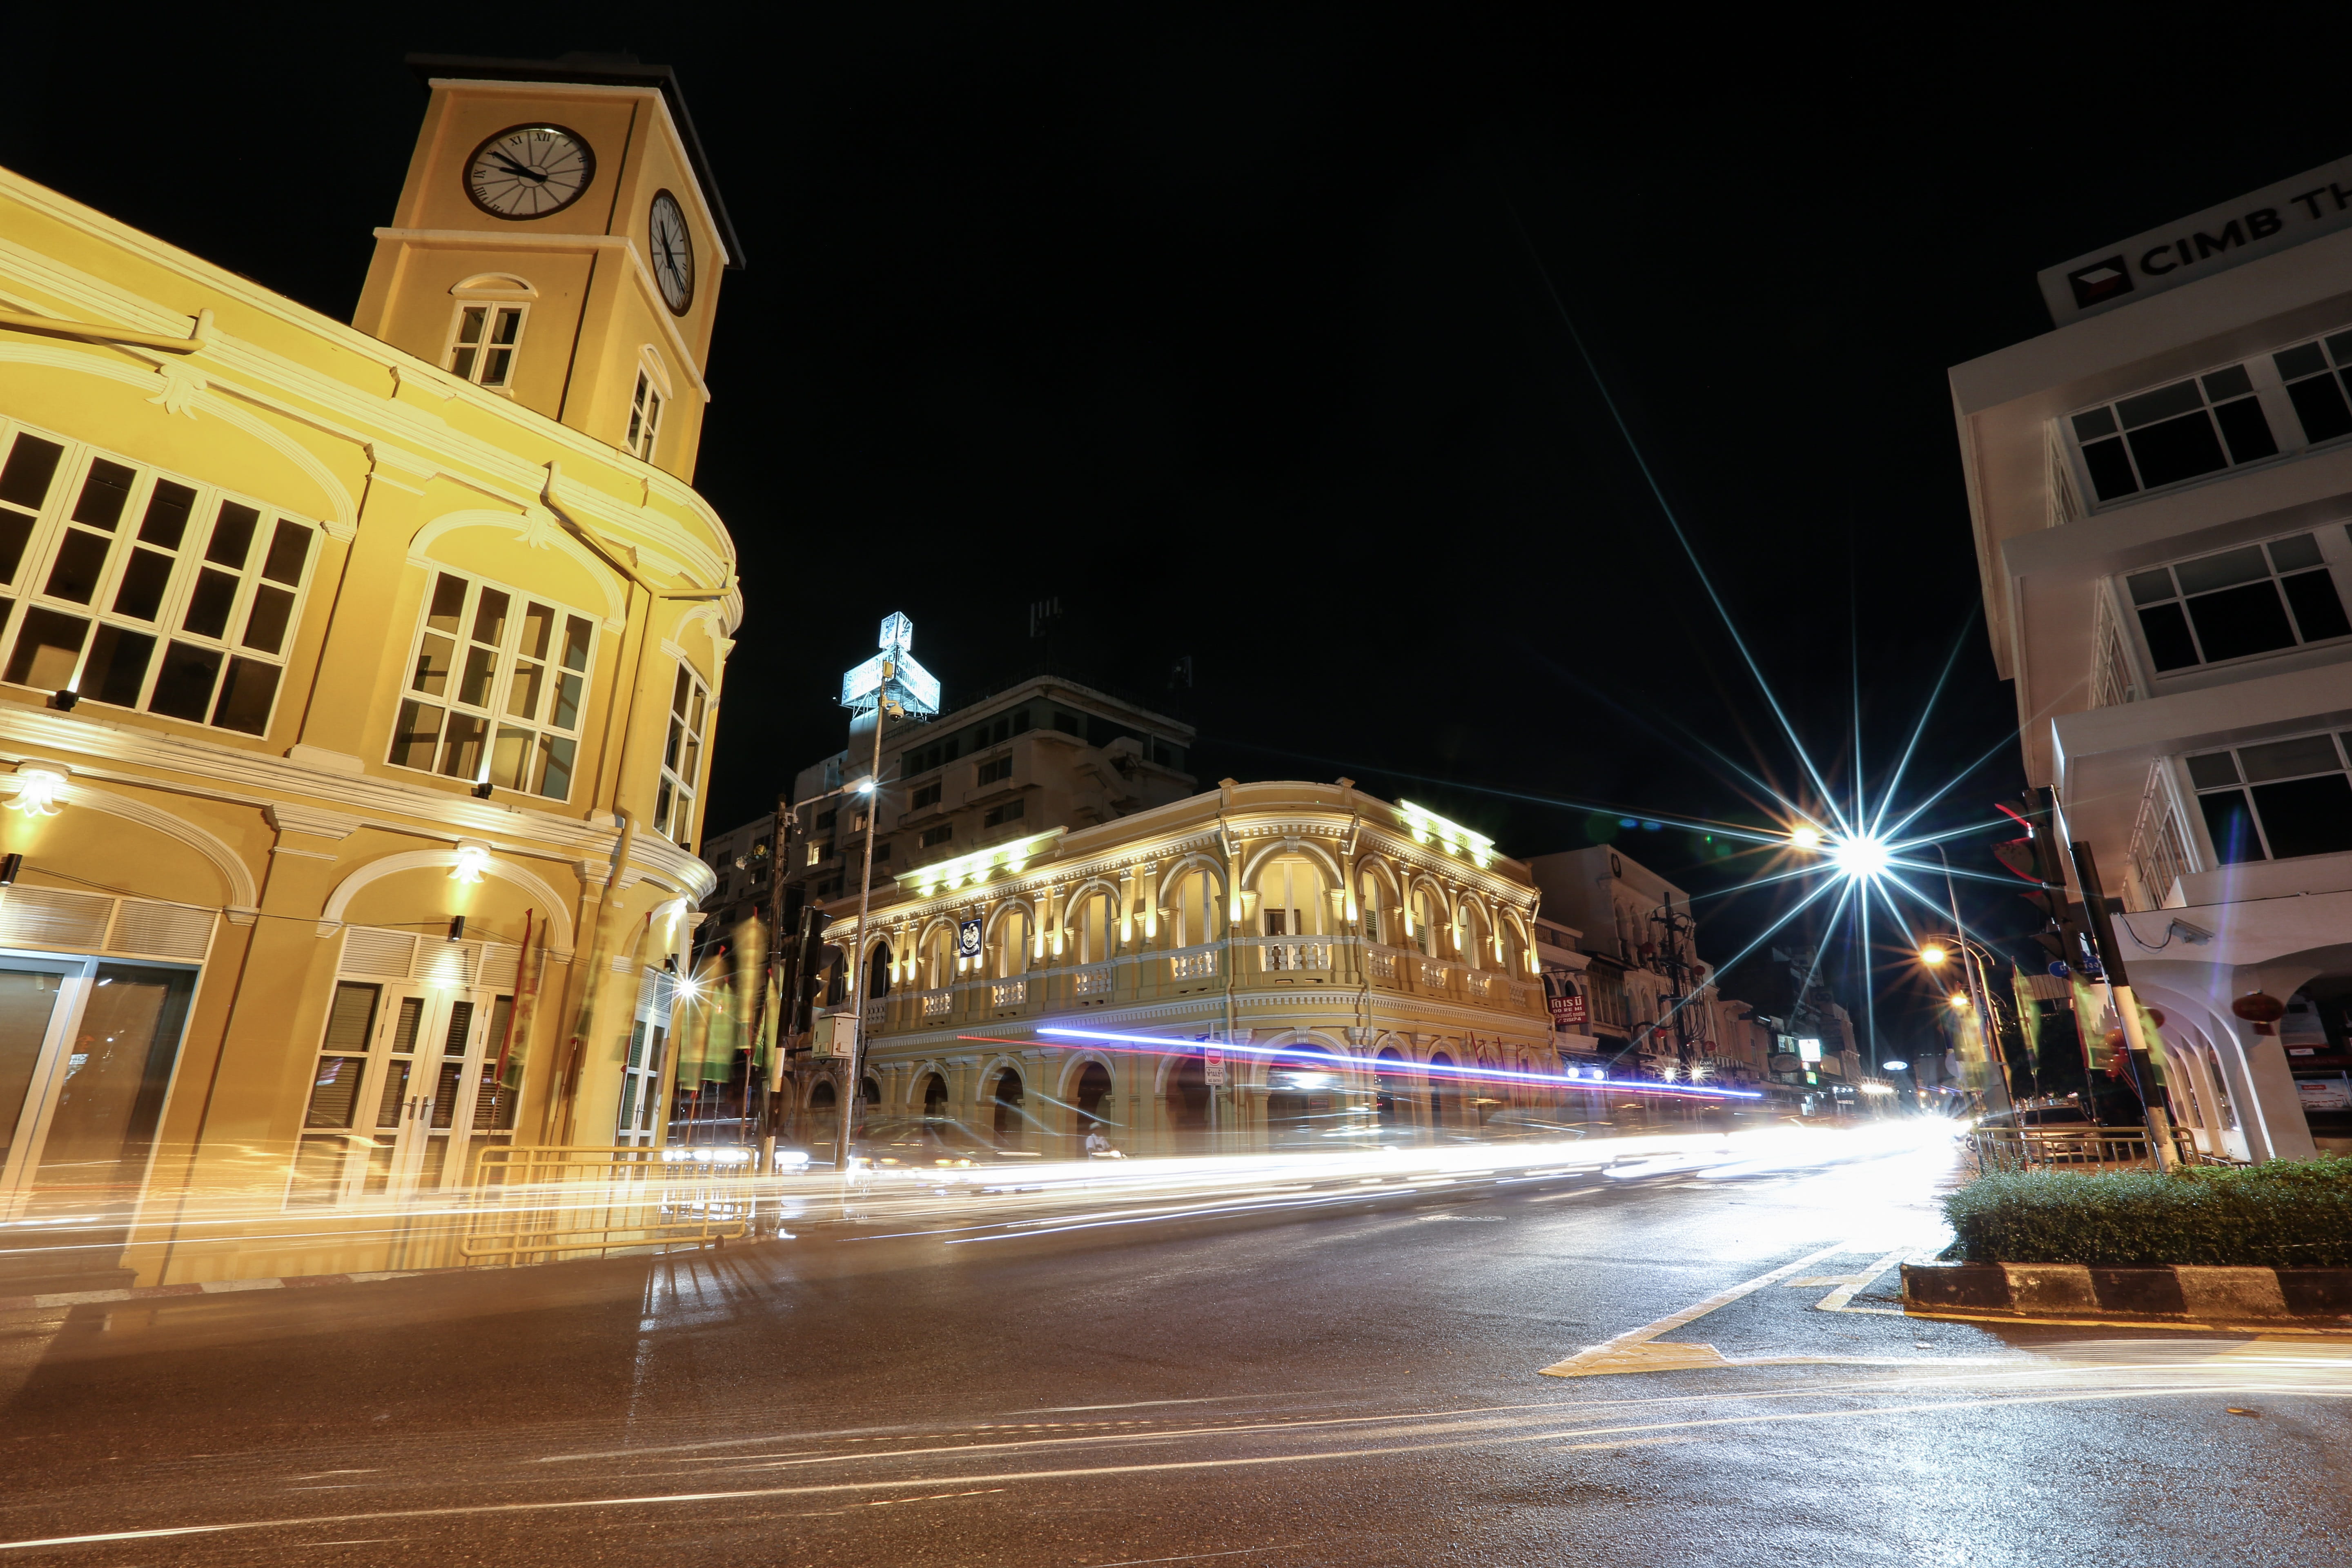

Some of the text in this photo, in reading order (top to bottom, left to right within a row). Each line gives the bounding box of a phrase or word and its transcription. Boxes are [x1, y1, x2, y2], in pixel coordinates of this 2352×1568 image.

[509, 136, 523, 147] XI
[534, 132, 551, 142] XII
[2140, 208, 2282, 275] CIMB
[1207, 1068, 1223, 1077] ห้ามเข้า
